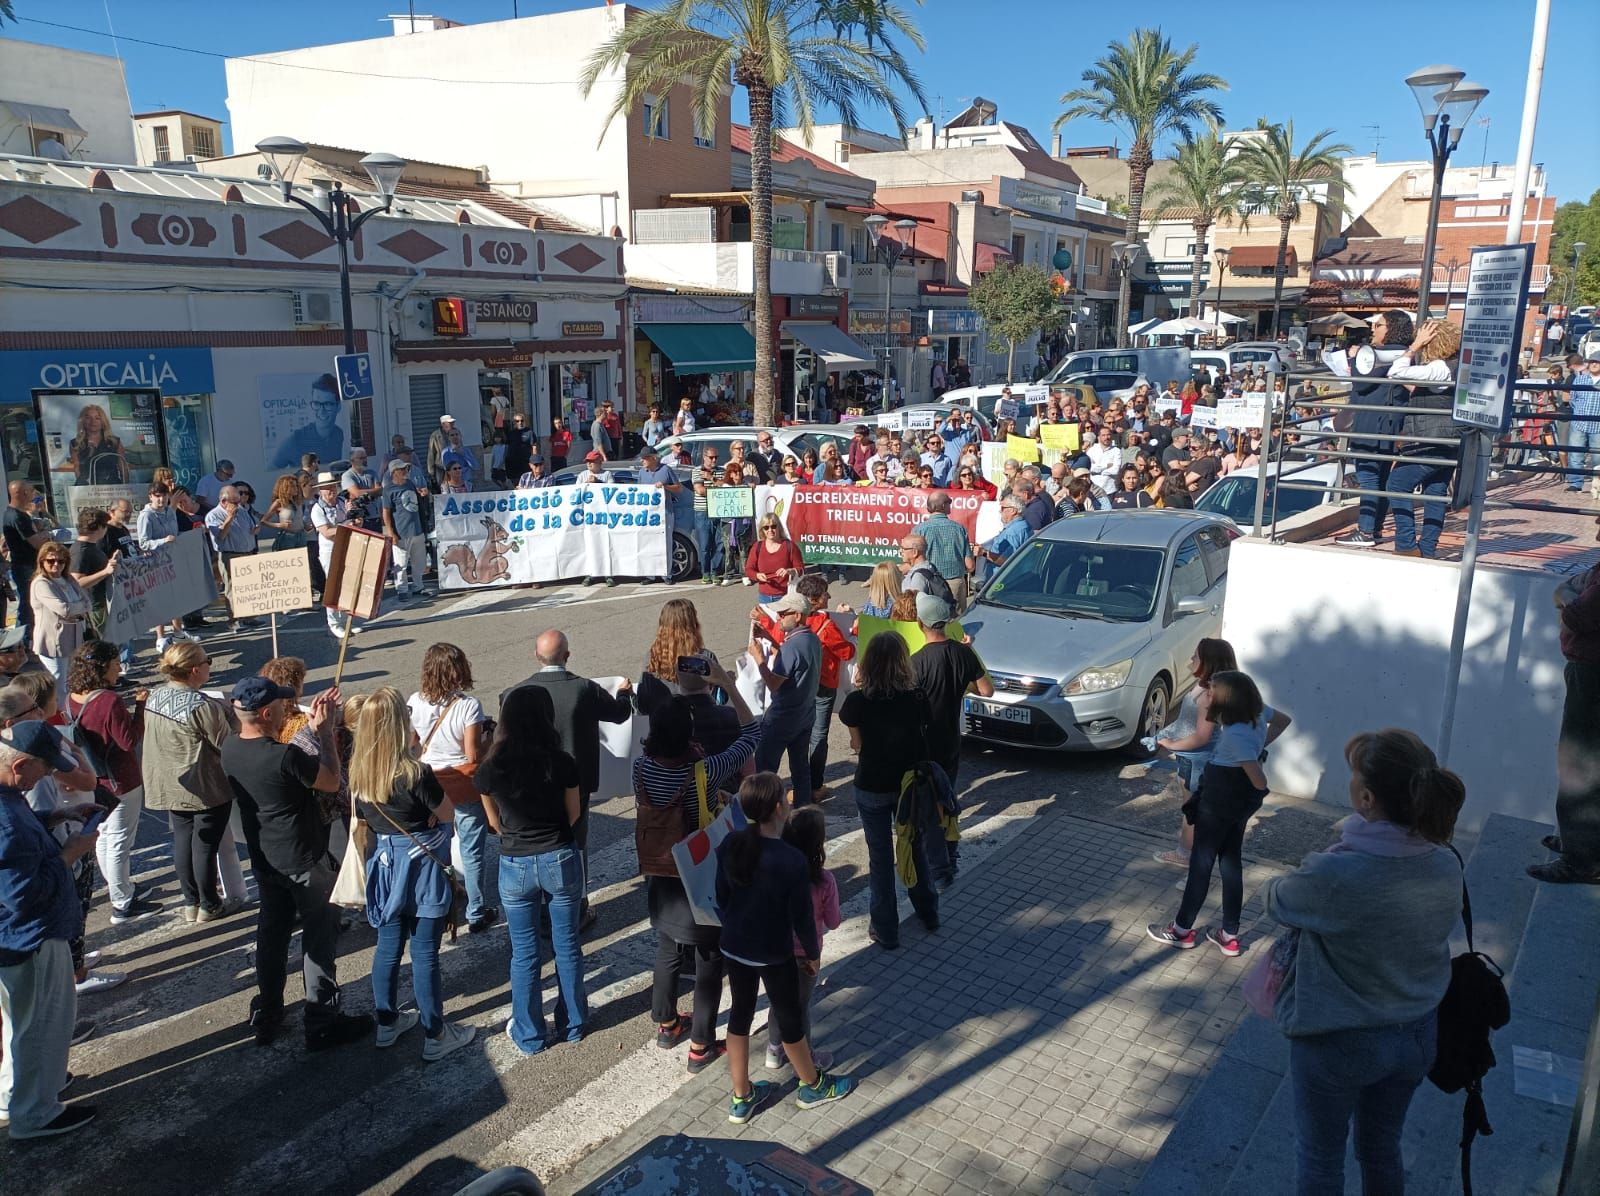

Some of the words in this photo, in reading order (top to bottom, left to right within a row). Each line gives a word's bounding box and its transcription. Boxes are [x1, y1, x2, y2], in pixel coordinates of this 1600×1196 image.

[476, 302, 531, 319] ESTANCO
[573, 323, 603, 332] TABACOS
[358, 358, 368, 377] P
[442, 488, 563, 516] Associació
[601, 486, 662, 506] Veïns
[712, 490, 747, 499] REDUCE
[795, 492, 894, 506] DECREIXEMENT
[898, 495, 909, 507] O
[912, 494, 978, 510] EXCIÓ
[510, 514, 535, 532] de
[543, 512, 561, 529] la
[569, 508, 661, 529] Canyada
[826, 509, 863, 522] TRIEU
[867, 512, 882, 524] LA
[886, 512, 929, 525] SOLUC
[800, 534, 815, 542] HO
[818, 535, 845, 544] TENIM
[875, 537, 890, 546] NO
[892, 538, 899, 546] A
[806, 545, 843, 556] BY-PASS,
[846, 546, 860, 555] NO
[862, 547, 869, 556] A
[234, 565, 252, 578] LOS
[258, 557, 304, 572] ARBOLES
[261, 572, 275, 583] NO
[292, 576, 299, 584] A
[270, 586, 308, 598] PARTIDO
[972, 701, 1000, 717] 0115
[1006, 708, 1028, 721] GPH
